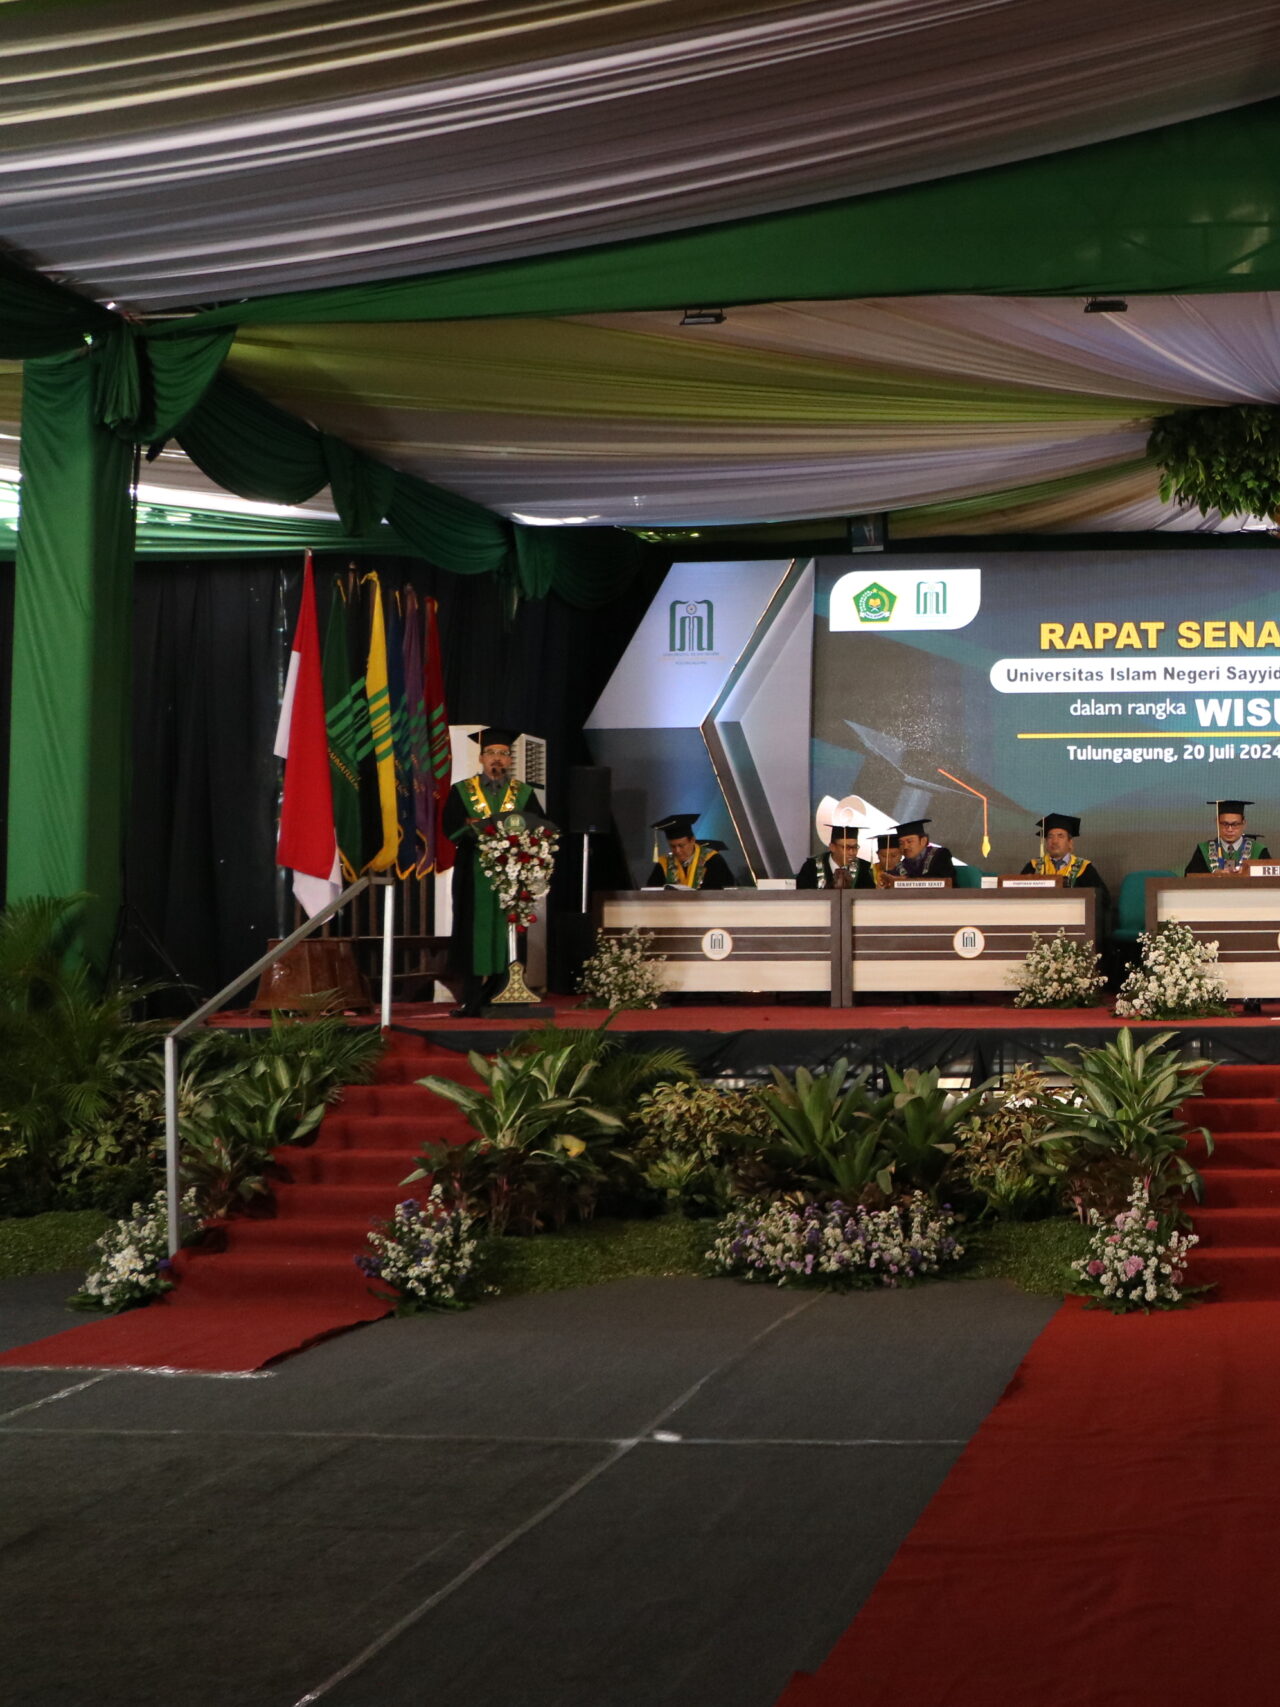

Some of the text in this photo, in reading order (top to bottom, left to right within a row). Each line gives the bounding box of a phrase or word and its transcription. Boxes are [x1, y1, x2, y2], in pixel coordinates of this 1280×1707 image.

[1040, 621, 1165, 650] RAPAT
[1006, 667, 1104, 682] Universitas
[1110, 667, 1157, 681] Islam
[1163, 667, 1220, 684] Negeri
[1069, 697, 1187, 720] dalam rangka
[1067, 744, 1179, 763] Tulungagung,
[1184, 744, 1205, 760] 20
[1208, 743, 1235, 762] Juli
